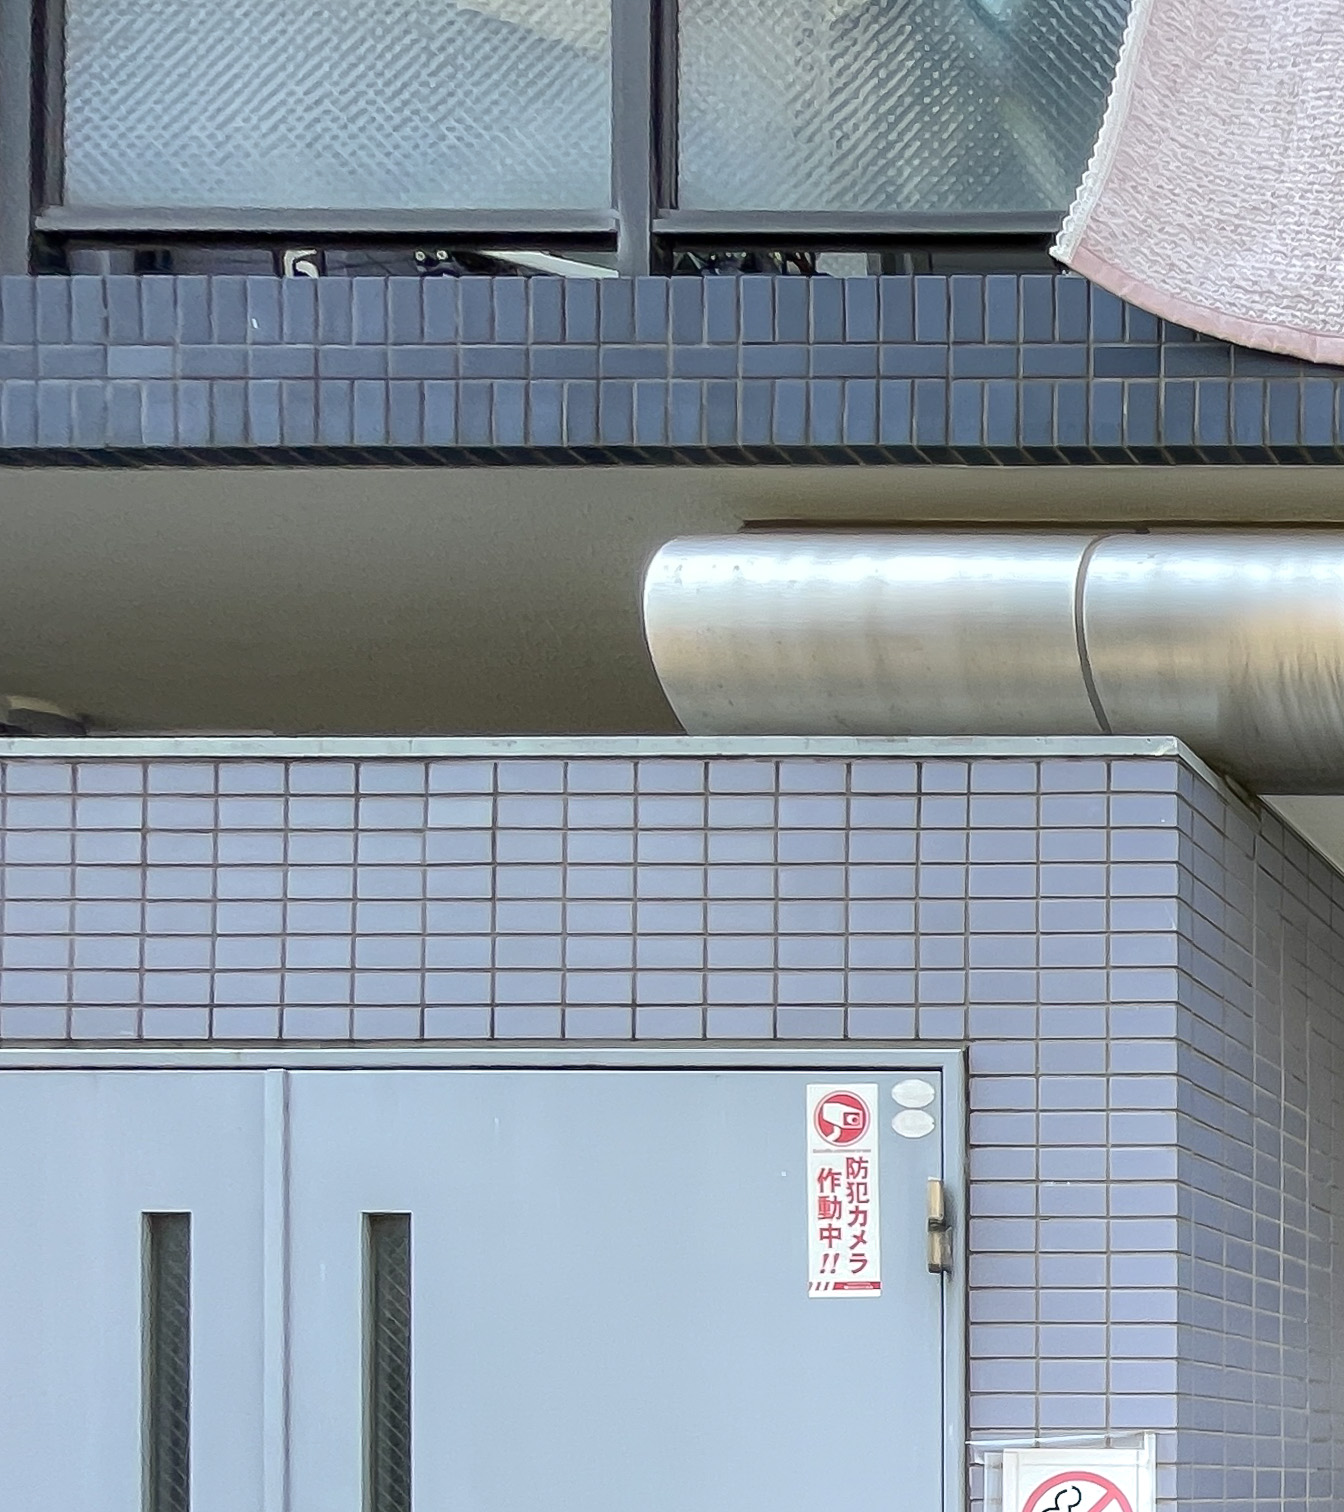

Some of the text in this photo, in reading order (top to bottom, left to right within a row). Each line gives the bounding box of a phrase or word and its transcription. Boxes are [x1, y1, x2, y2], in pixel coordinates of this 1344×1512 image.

[845, 1156, 870, 1274] 防犯カメラ
